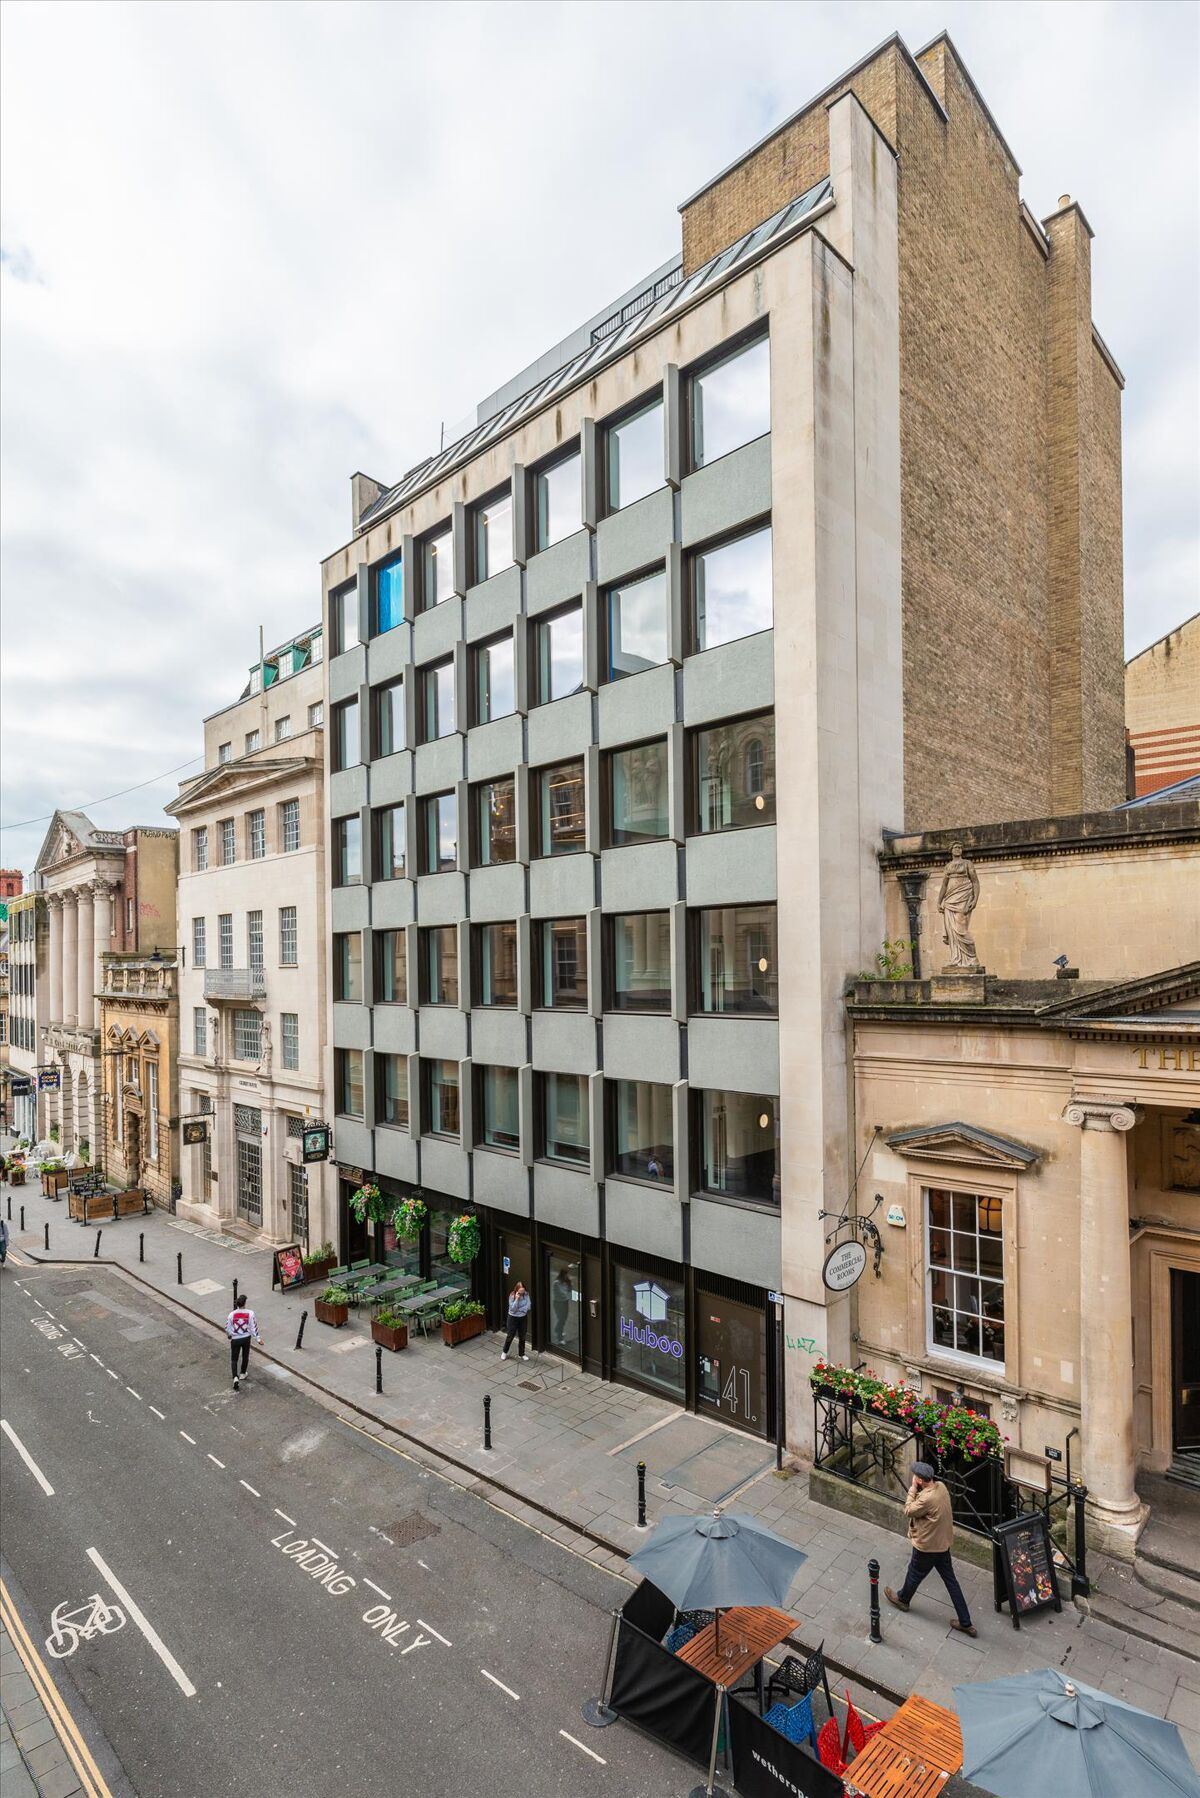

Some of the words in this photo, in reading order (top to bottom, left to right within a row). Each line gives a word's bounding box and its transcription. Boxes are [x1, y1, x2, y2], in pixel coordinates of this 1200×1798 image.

[829, 1255, 863, 1276] COMMERCIAL
[836, 1267, 855, 1280] ROOMS
[841, 1251, 852, 1262] THE
[30, 1316, 63, 1339] LOADING
[57, 1343, 86, 1360] ONLY
[620, 1315, 684, 1358] Huboo
[271, 1530, 356, 1595] LOADING
[362, 1605, 431, 1655] ONLY
[751, 1749, 809, 1798] wethersp
